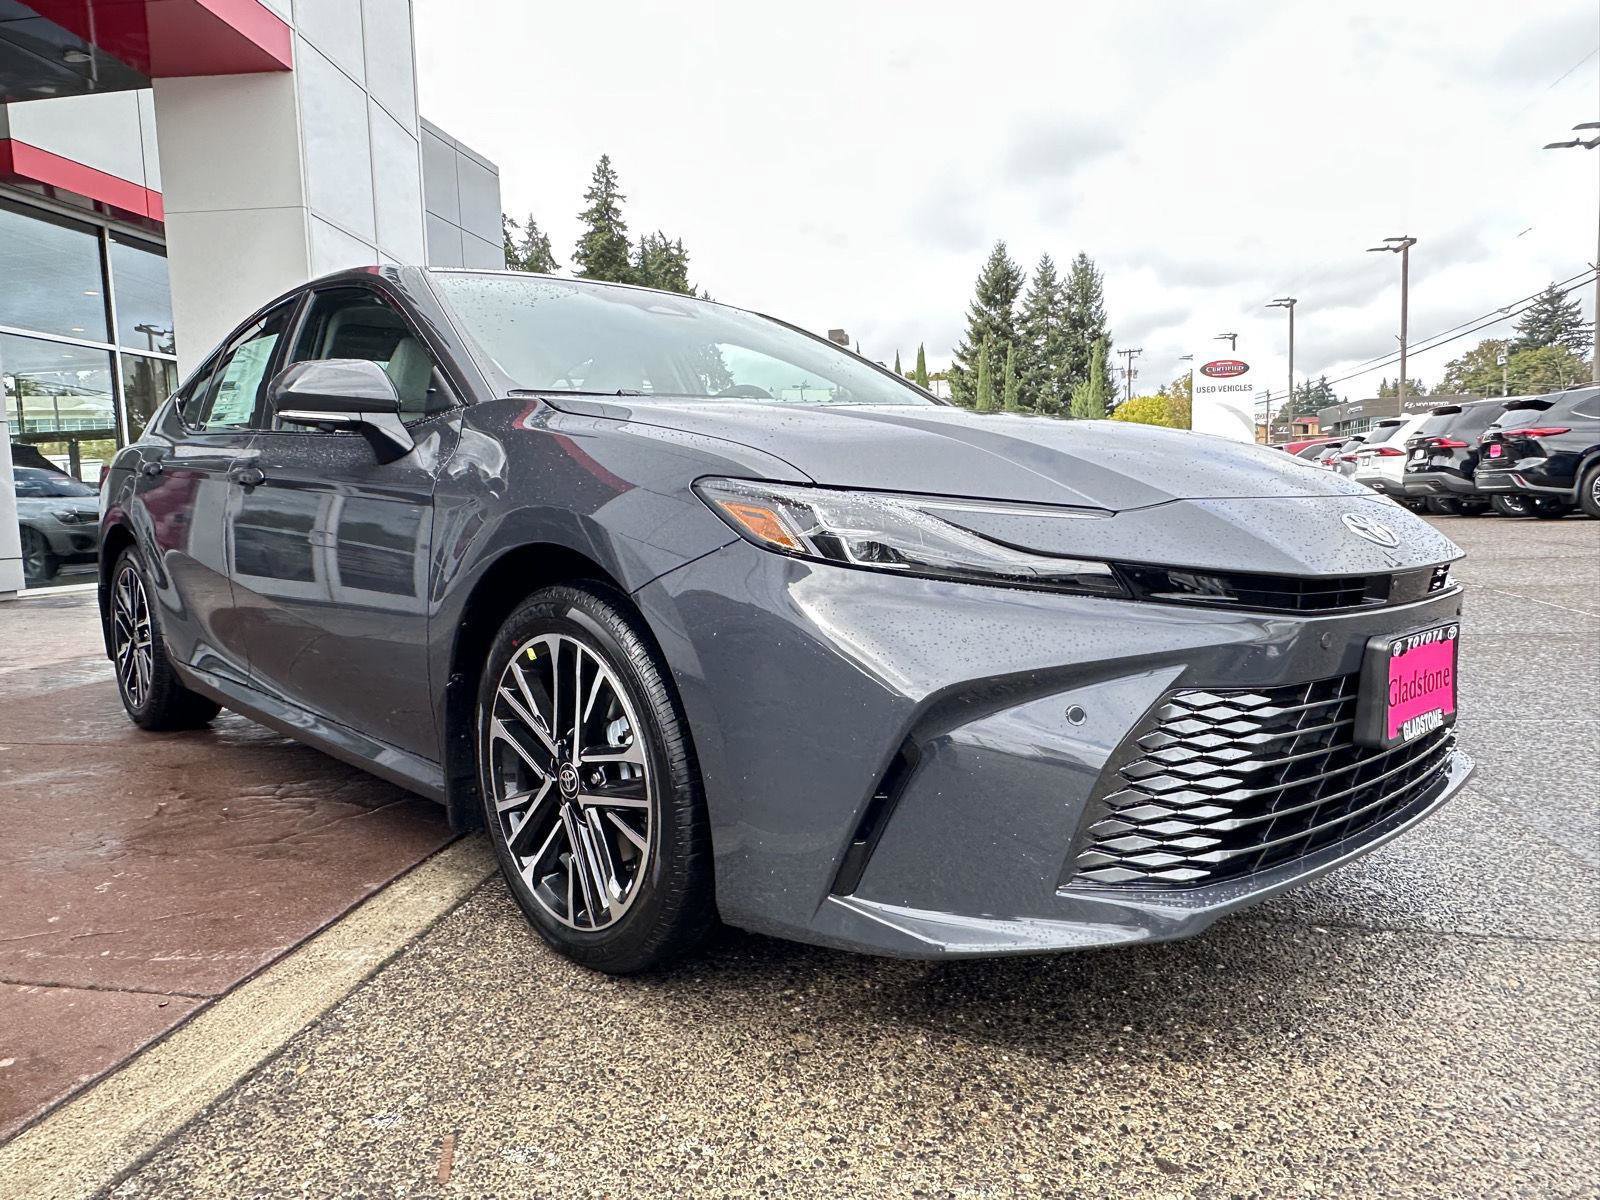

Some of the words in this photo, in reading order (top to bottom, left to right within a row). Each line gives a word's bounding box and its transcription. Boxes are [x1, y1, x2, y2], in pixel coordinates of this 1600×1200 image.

[1196, 385, 1216, 394] USED
[1218, 384, 1253, 393] VEHICLES
[1407, 629, 1443, 650] TOYOTA
[1389, 667, 1450, 708] Gladstone
[1403, 708, 1444, 742] GLADSTONE
